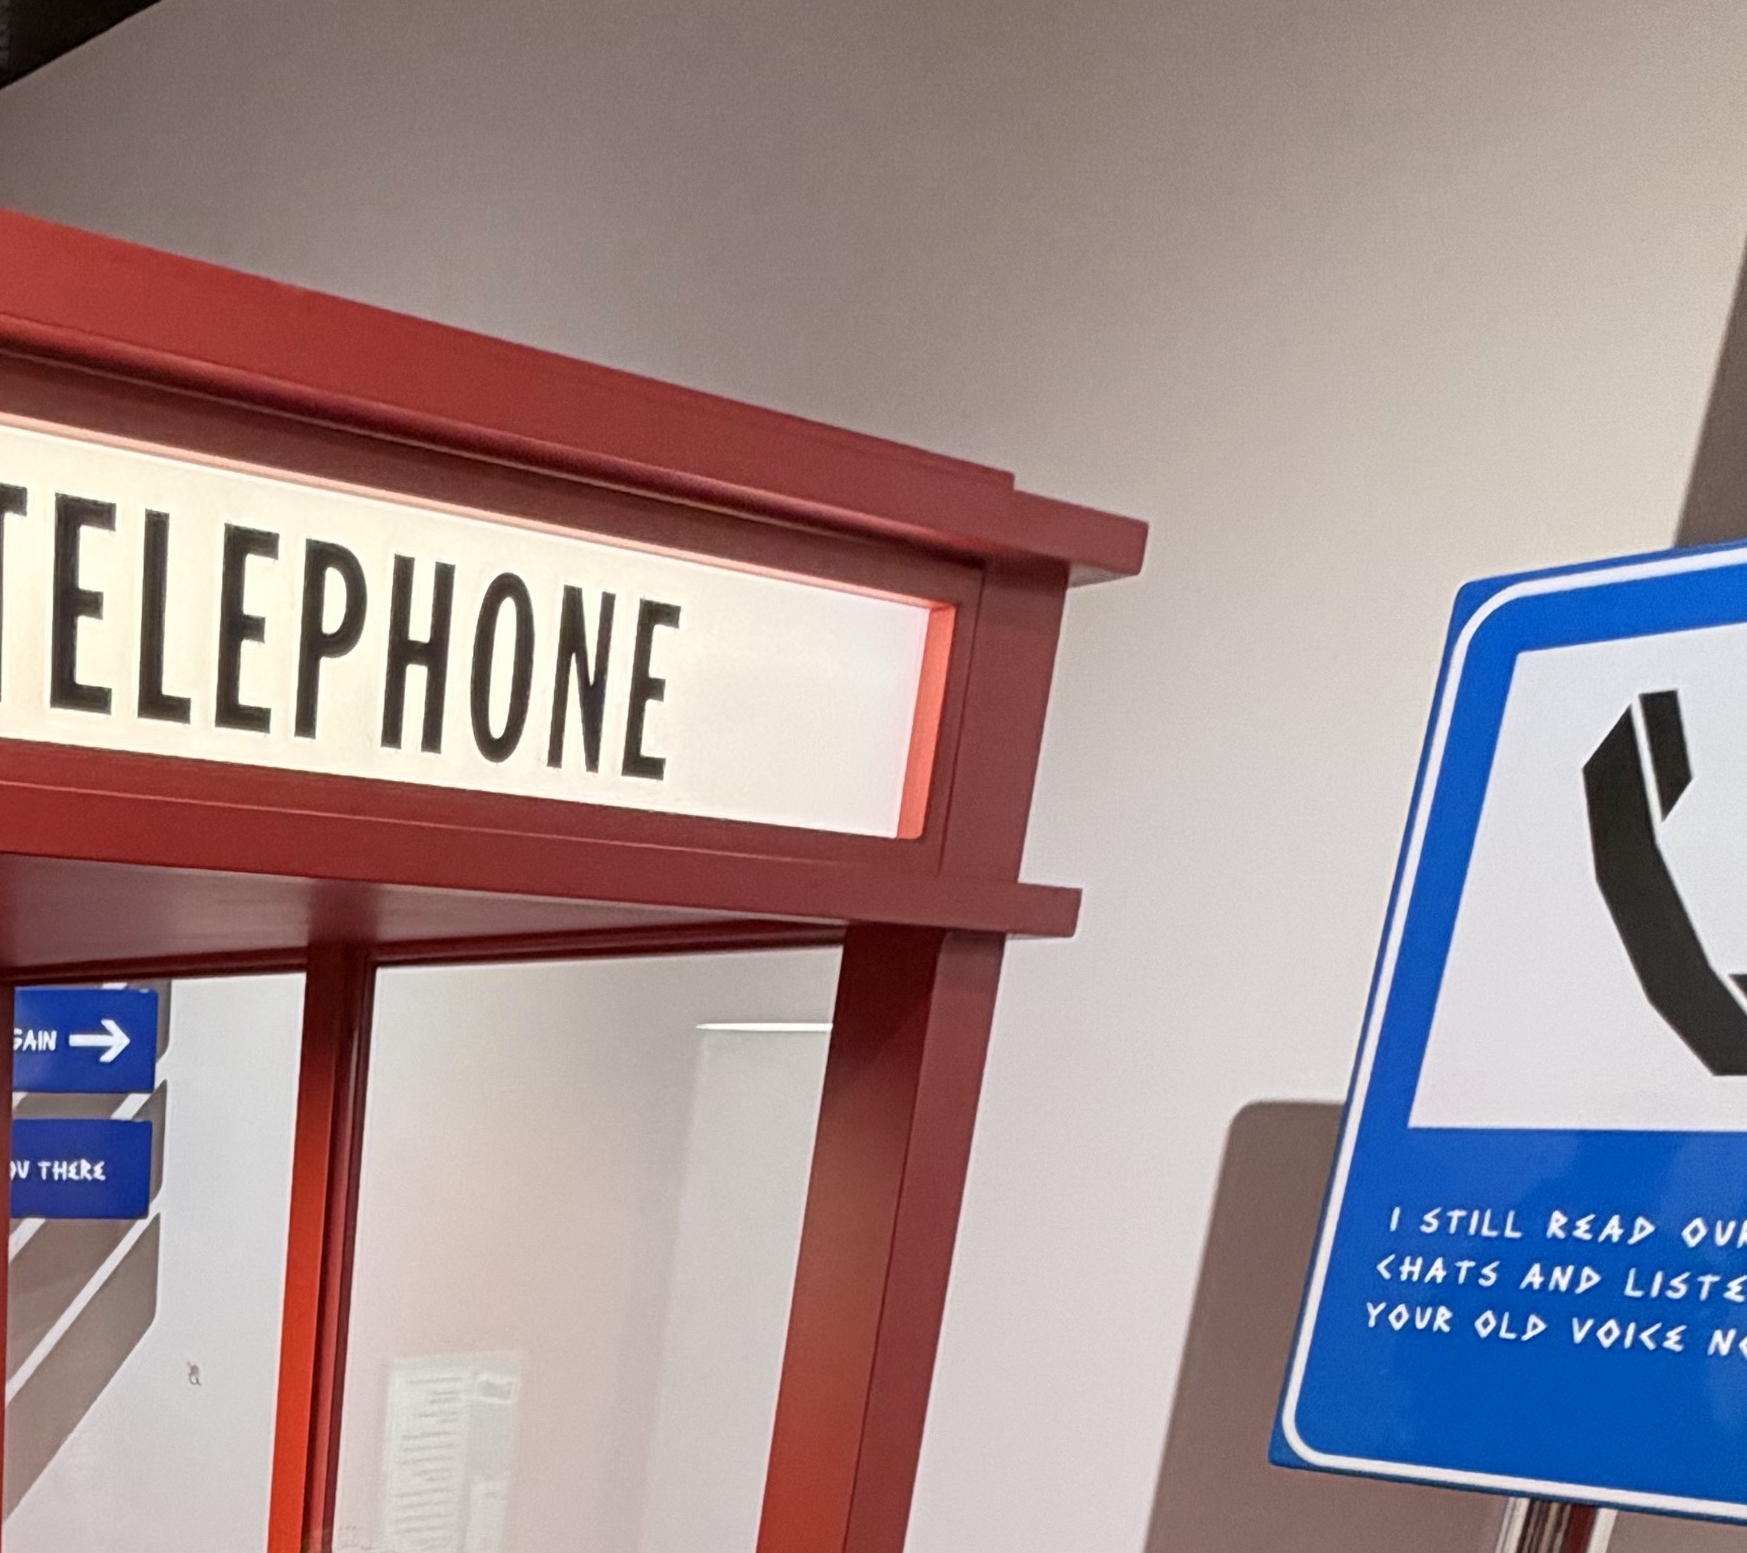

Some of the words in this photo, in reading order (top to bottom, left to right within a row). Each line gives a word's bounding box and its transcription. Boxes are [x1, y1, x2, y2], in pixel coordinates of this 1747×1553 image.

[37, 1158, 107, 1182] THERE
[1389, 1206, 1401, 1232] I
[1419, 1206, 1523, 1239] STILL
[1546, 1209, 1656, 1246] READ
[1376, 1253, 1500, 1288] CHATS
[1519, 1262, 1601, 1295] AND
[1366, 1301, 1453, 1334] YOUR
[1474, 1309, 1548, 1342] OLD
[1572, 1316, 1688, 1353] VOICE
